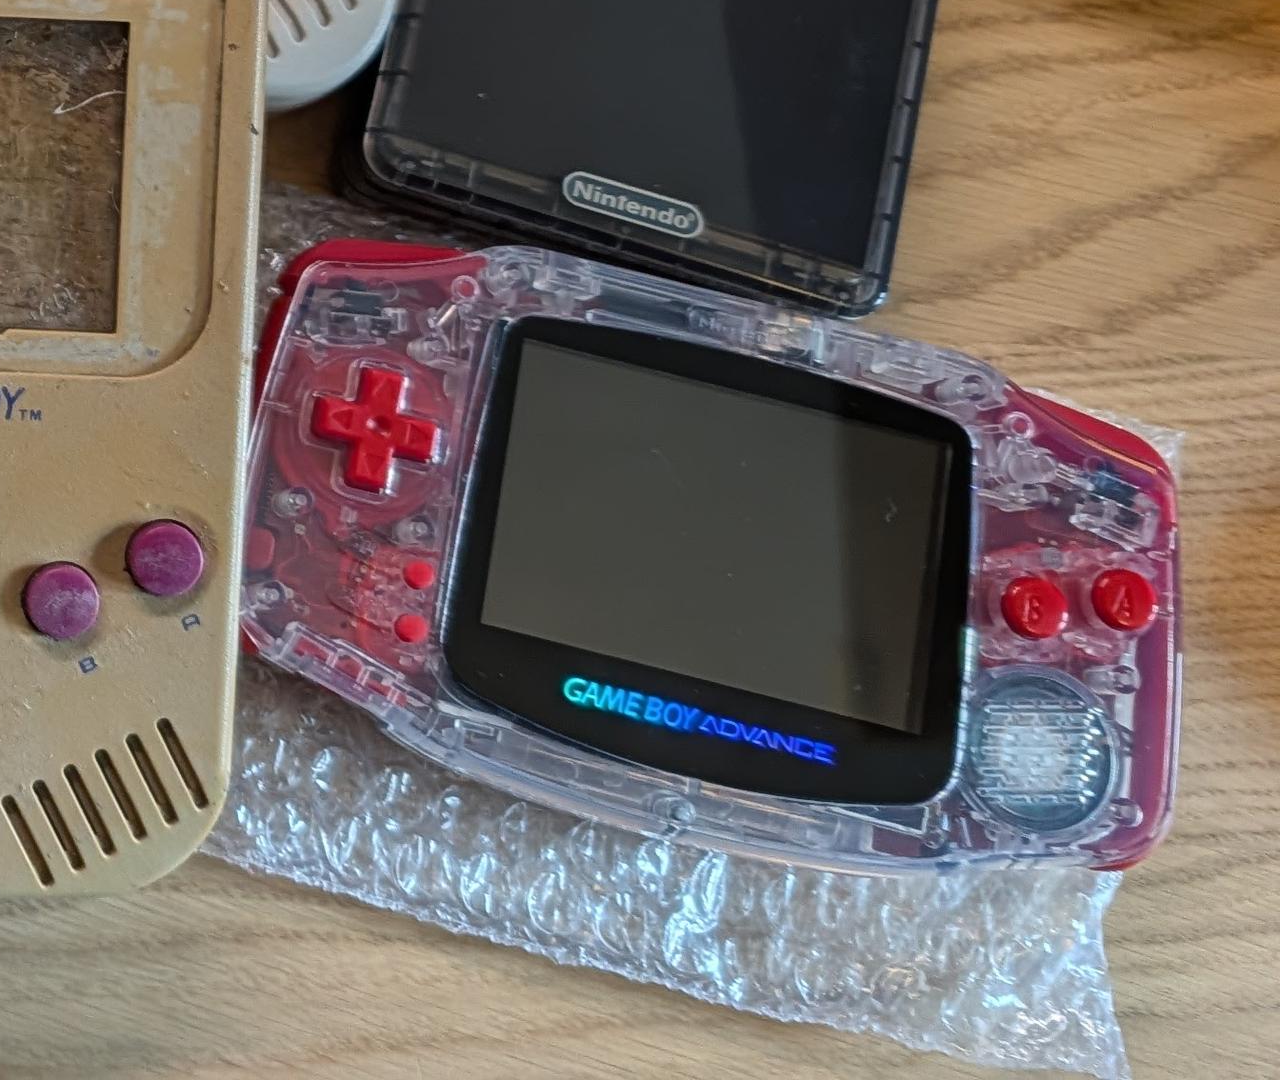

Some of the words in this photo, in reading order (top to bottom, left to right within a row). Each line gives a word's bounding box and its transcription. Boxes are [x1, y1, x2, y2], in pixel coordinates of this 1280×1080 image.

[572, 180, 689, 229] Nintendo
[562, 676, 644, 719] GAME
[643, 696, 701, 731] BOY
[698, 715, 837, 766] ADVANCE
